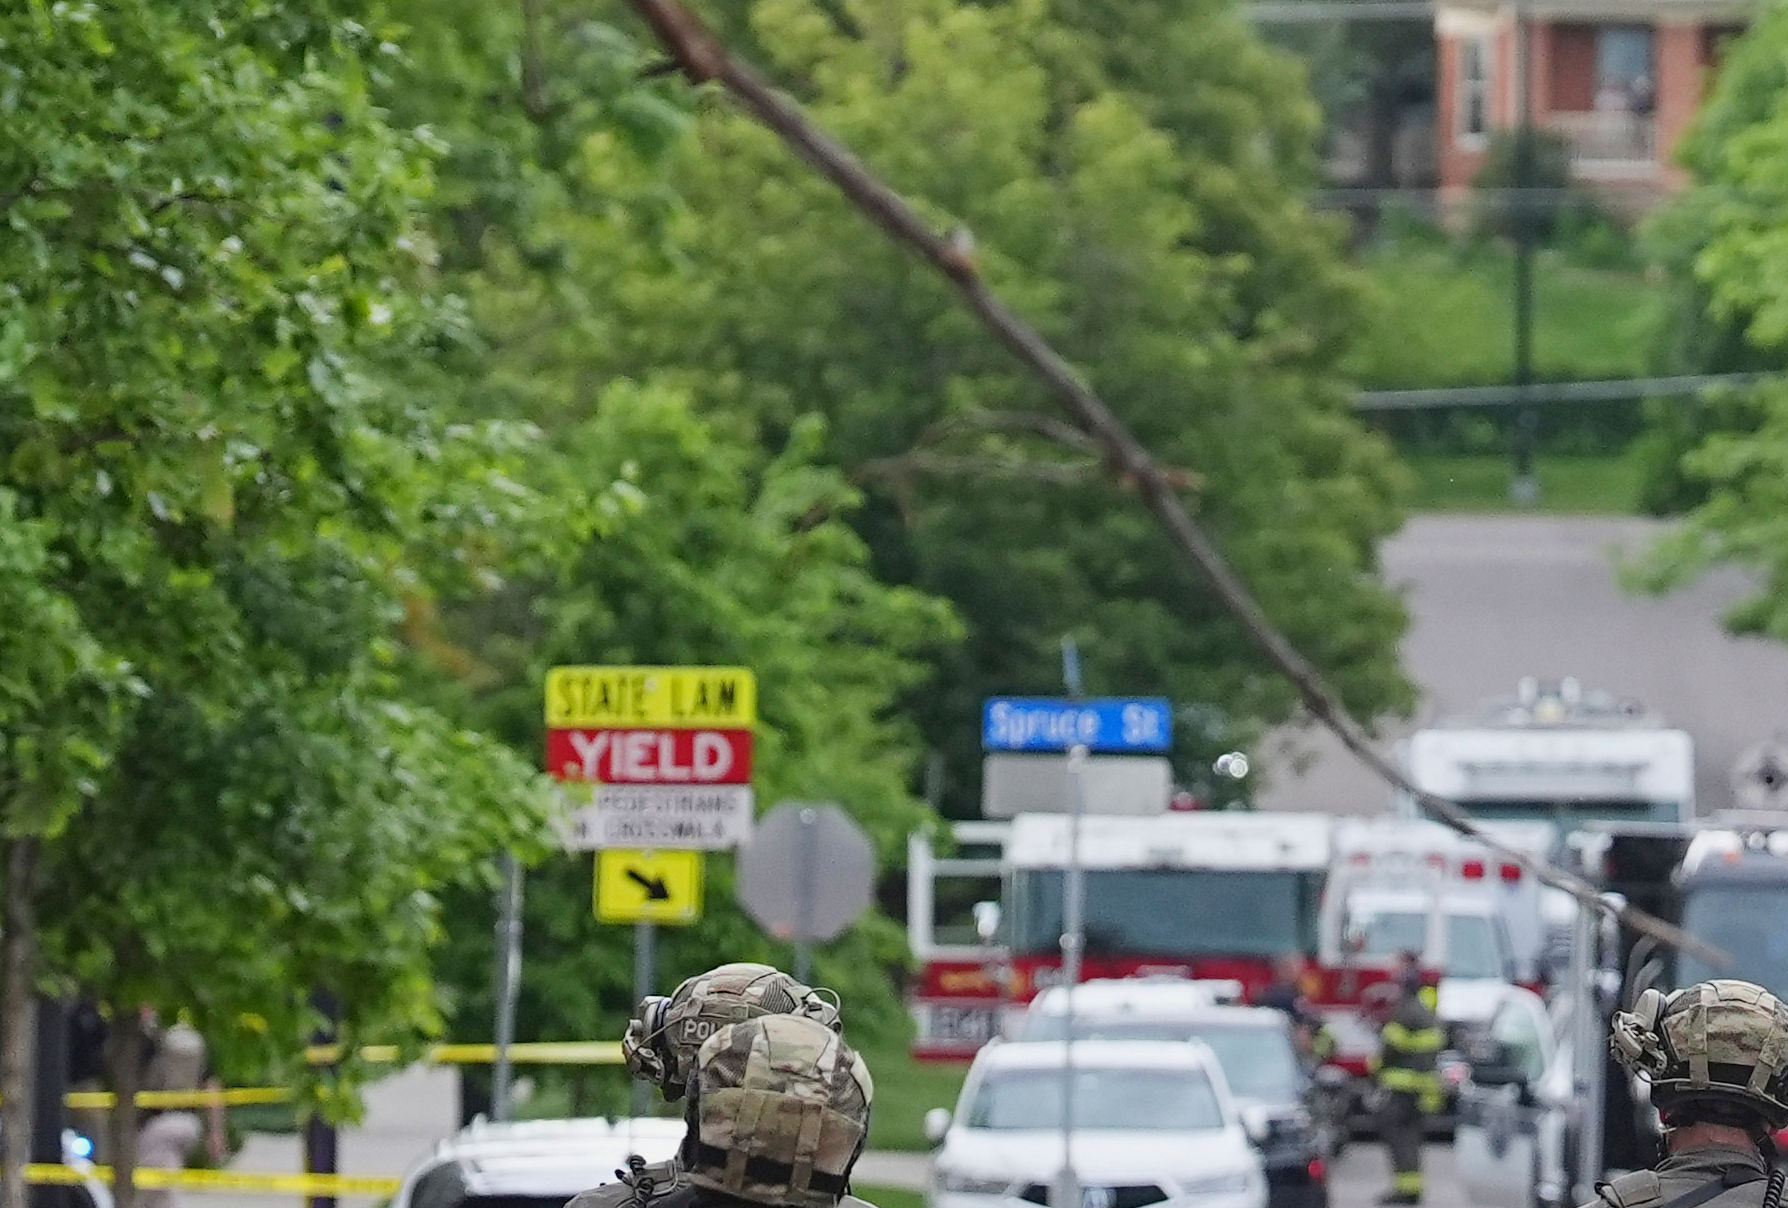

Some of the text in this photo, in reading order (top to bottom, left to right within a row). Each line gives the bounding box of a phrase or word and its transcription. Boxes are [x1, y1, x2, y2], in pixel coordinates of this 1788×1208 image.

[557, 676, 739, 717] STATE LAW
[988, 702, 1160, 749] Spruce St
[568, 731, 734, 781] YIELD
